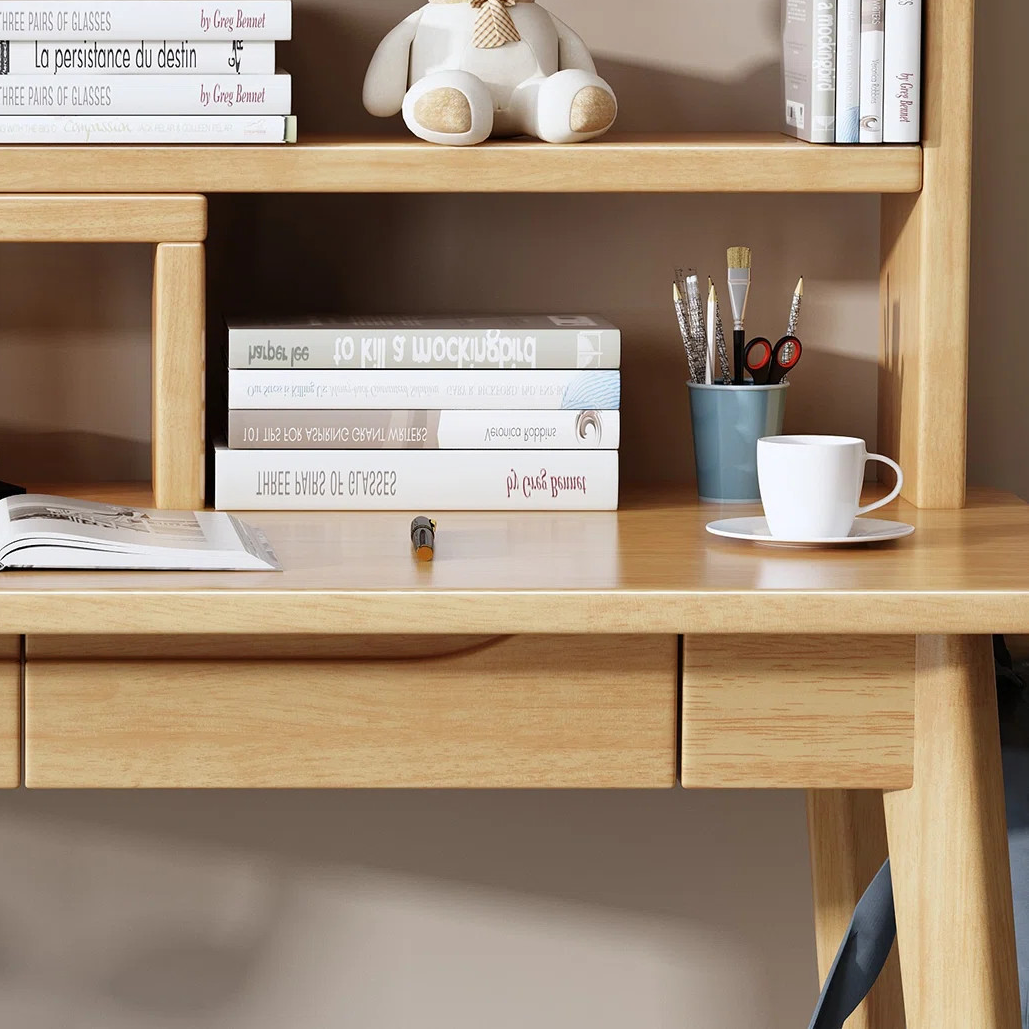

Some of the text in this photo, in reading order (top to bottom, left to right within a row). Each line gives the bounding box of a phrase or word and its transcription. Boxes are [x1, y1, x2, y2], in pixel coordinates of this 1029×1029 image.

[817, 1, 834, 11] a
[28, 11, 54, 31] PAIRS
[57, 11, 69, 31] OF
[72, 11, 112, 31] GLASSES
[200, 8, 266, 33] by Greg Bennet
[35, 40, 49, 69] La
[54, 40, 131, 75] persistance
[136, 40, 152, 69] du
[157, 40, 197, 69] destin
[812, 14, 836, 91] mockingbird
[28, 86, 54, 106] PAIRS
[57, 86, 69, 106] OF
[72, 86, 112, 106] GLASSES
[200, 83, 266, 107] by Greg Bennet
[895, 82, 914, 99] Greg
[899, 100, 913, 123] Bennet
